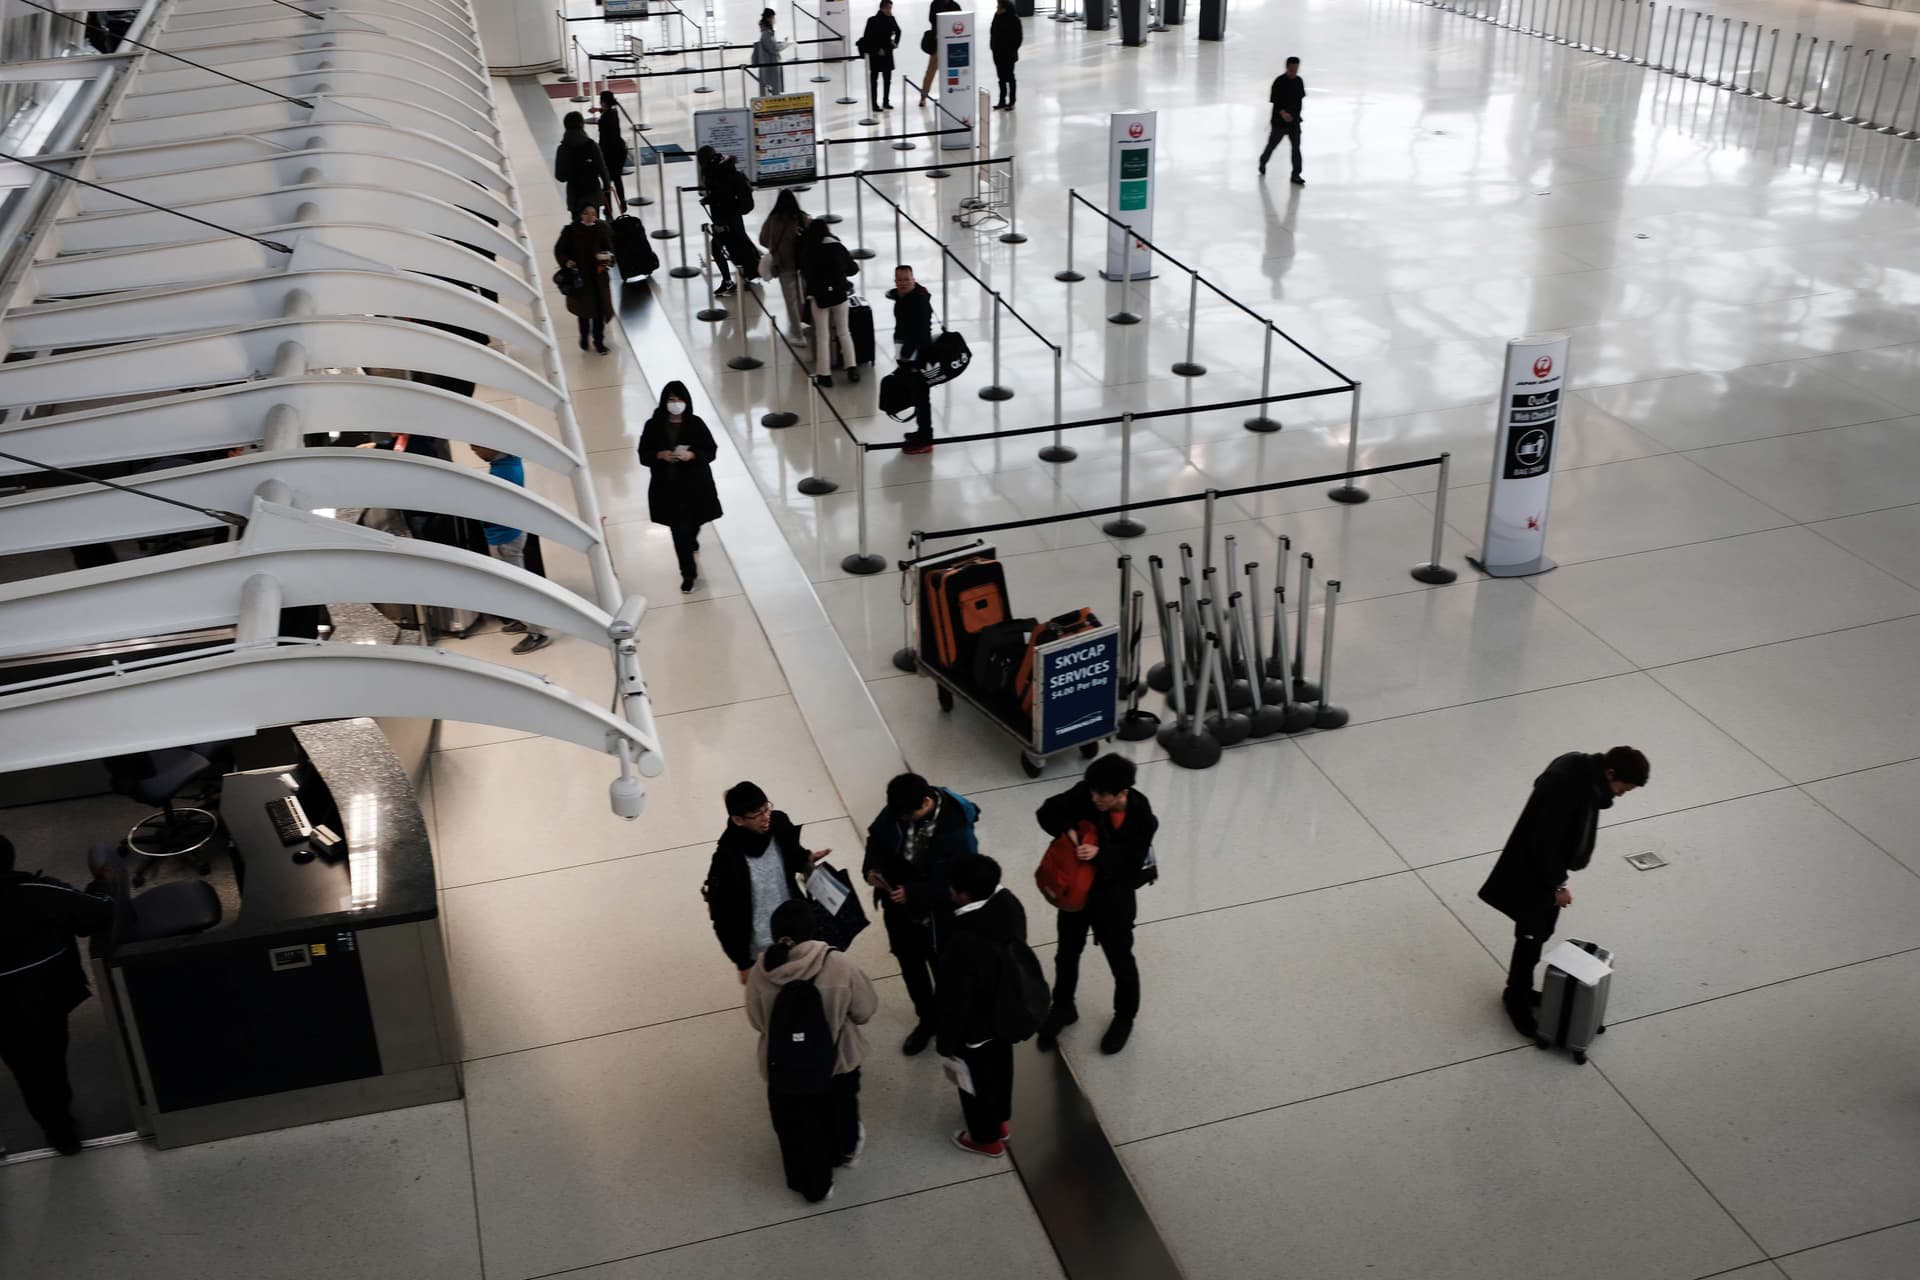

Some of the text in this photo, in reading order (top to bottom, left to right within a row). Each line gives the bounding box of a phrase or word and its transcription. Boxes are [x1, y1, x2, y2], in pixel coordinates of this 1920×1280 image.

[1055, 644, 1105, 669] SKYCAP
[1050, 660, 1110, 688] SERVICES
[1076, 682, 1090, 691] Per
